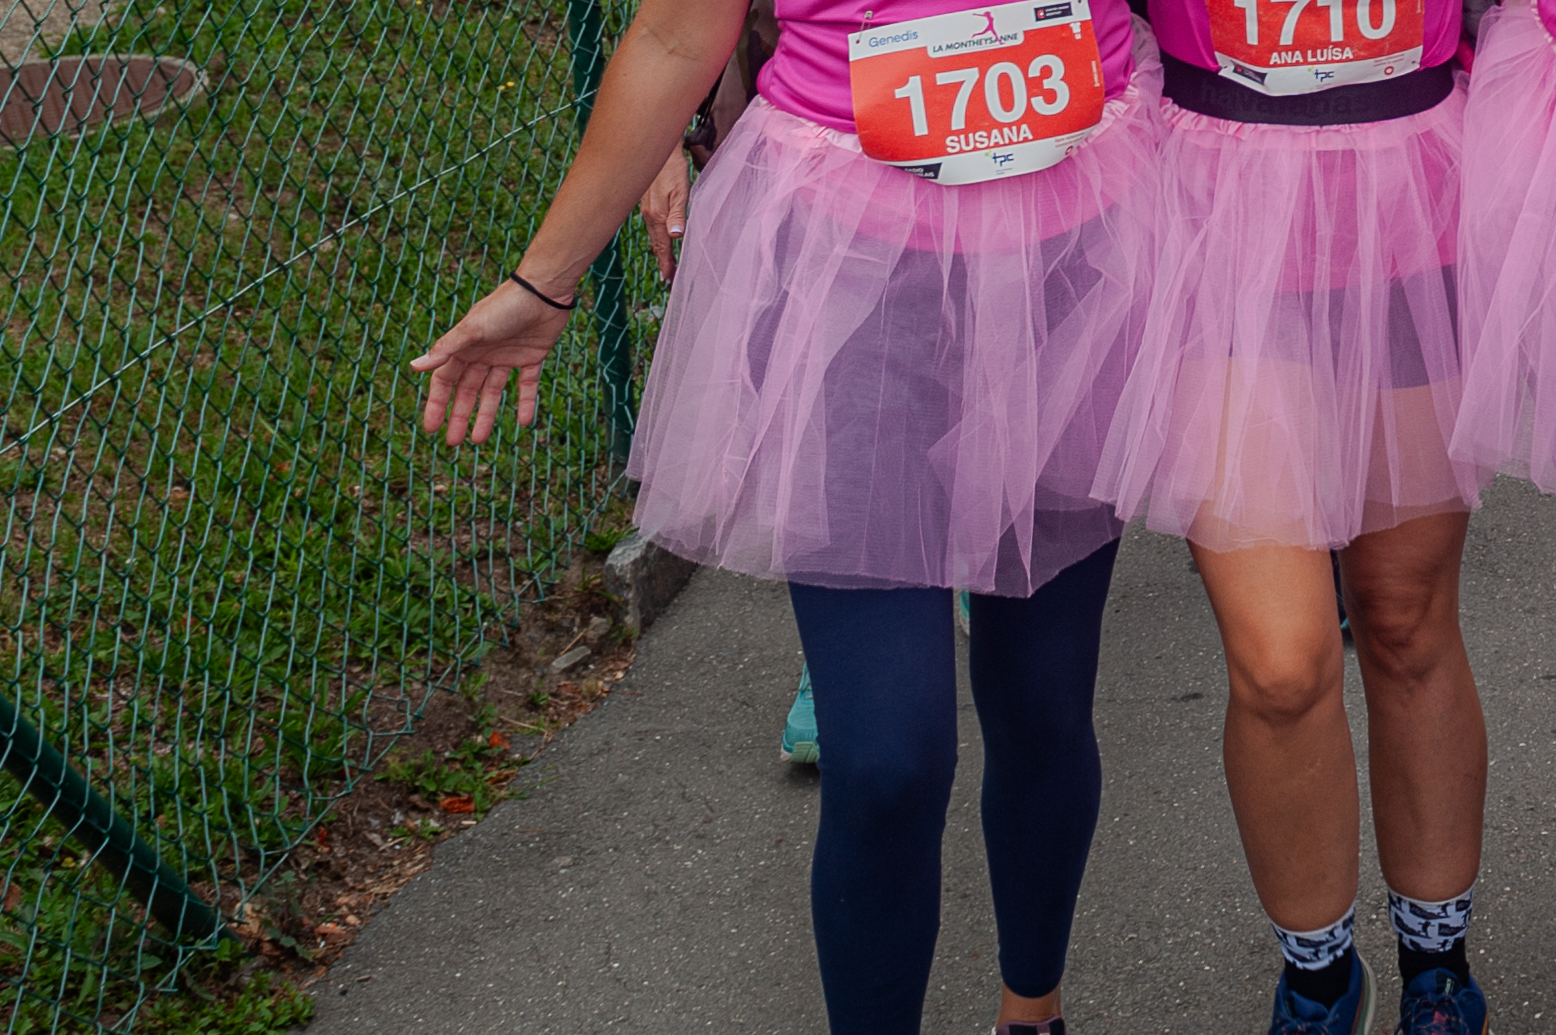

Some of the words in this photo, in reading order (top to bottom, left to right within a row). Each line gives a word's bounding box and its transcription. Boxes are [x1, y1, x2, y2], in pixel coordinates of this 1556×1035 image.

[868, 30, 919, 48] Genedis
[932, 44, 944, 53] LA
[945, 33, 1018, 52] MONTHEYSANNE
[1269, 51, 1303, 65] ANA
[1307, 45, 1353, 63] LUÍSA
[894, 54, 1070, 137] 1703
[945, 124, 1033, 153] SUSANA
